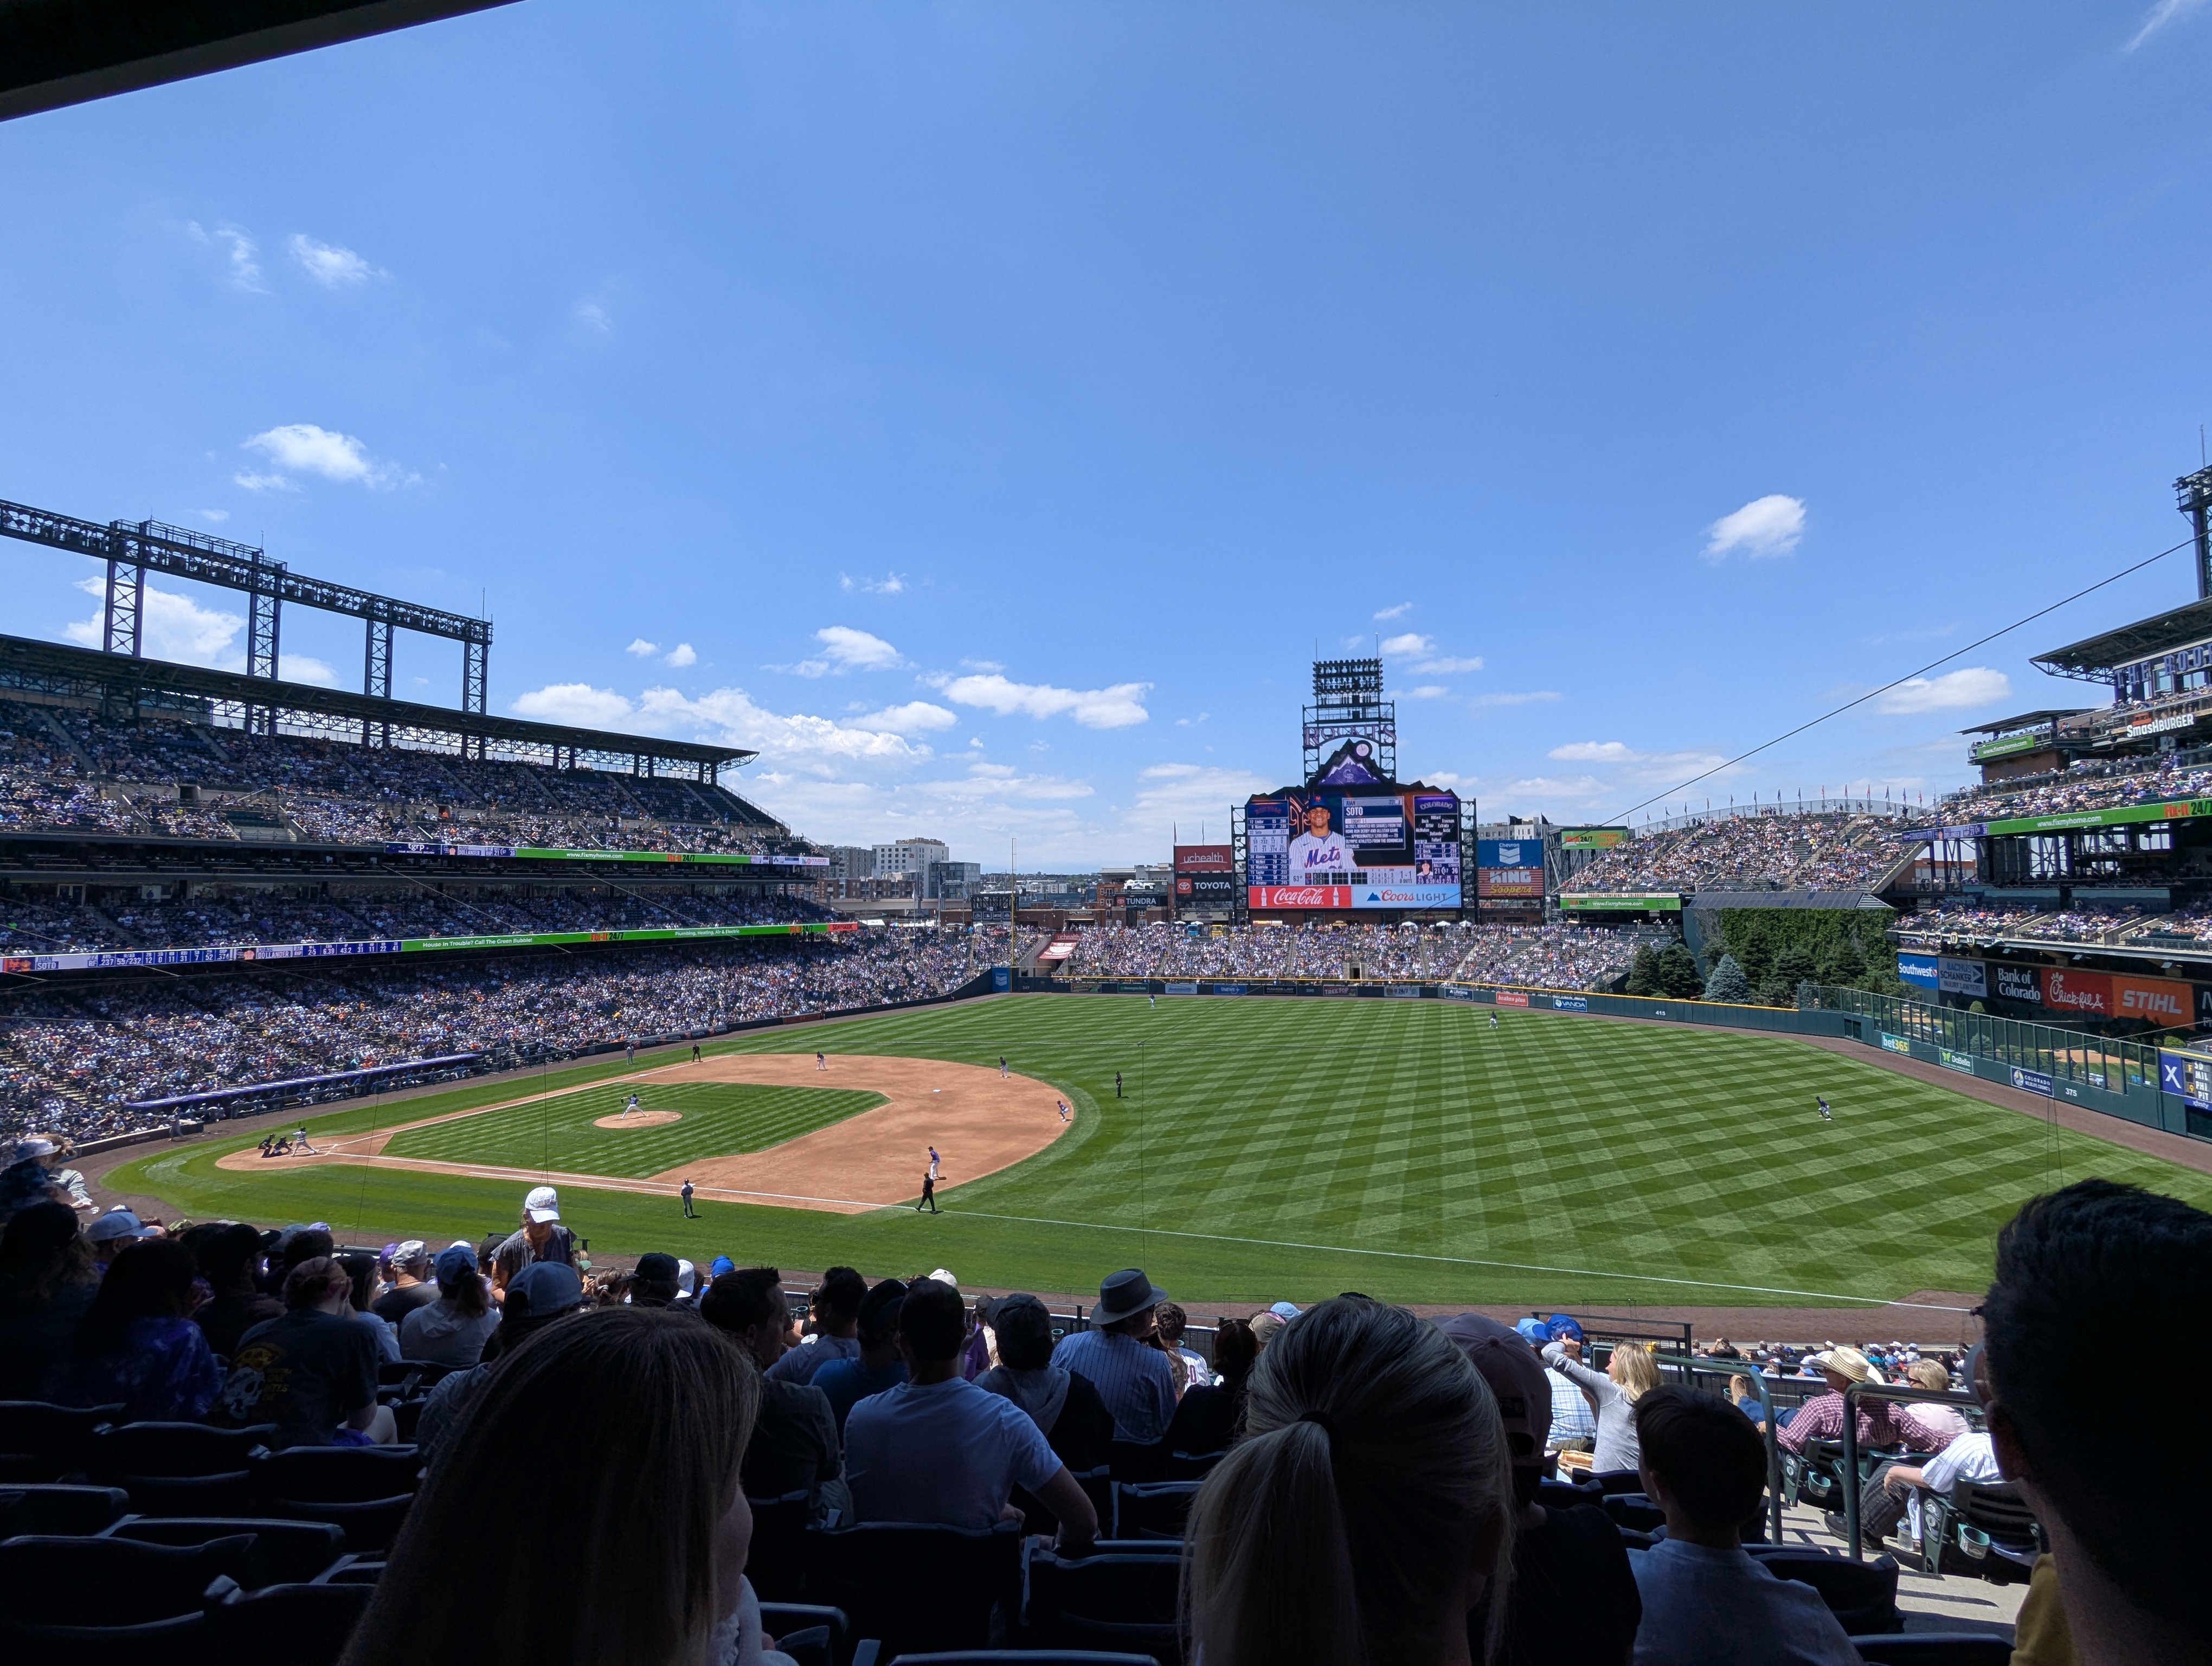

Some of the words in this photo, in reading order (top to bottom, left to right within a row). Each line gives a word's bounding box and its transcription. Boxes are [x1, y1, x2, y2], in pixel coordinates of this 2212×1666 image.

[2115, 661, 2151, 689] THE
[1346, 806, 1364, 816] SOTO
[1420, 801, 1453, 810] COLORADO
[2037, 815, 2102, 828] www.fixmyhome.com
[1184, 852, 1224, 863] uchealth
[1304, 846, 1341, 868] Mets
[1489, 871, 1531, 883] KING
[1381, 889, 1414, 901] Coors
[1416, 893, 1447, 902] LIGHT
[1489, 883, 1533, 896] Soopers
[1273, 887, 1325, 906] Coca-Cola
[609, 932, 624, 940] 24/7
[99, 958, 114, 966] .237
[116, 957, 142, 966] 55/232
[1898, 963, 1933, 977] Southwest
[1997, 968, 2021, 983] Bank
[2021, 970, 2031, 984] of
[1940, 970, 1972, 983] SCHANKER
[1960, 982, 1982, 992] LAWYERS
[1999, 982, 2041, 1001] Colorado
[2122, 990, 2182, 1015] STIHL
[1883, 1035, 1908, 1052] bet365
[1951, 1055, 1971, 1067] DaBella
[2194, 1062, 2204, 1071] SD
[2024, 1075, 2051, 1086] COLORADO
[2195, 1071, 2209, 1081] MIL
[2065, 1087, 2078, 1097] 375
[2188, 1084, 2195, 1093] 9
[2195, 1080, 2208, 1091] PHI
[2197, 1091, 2209, 1100] PIT
